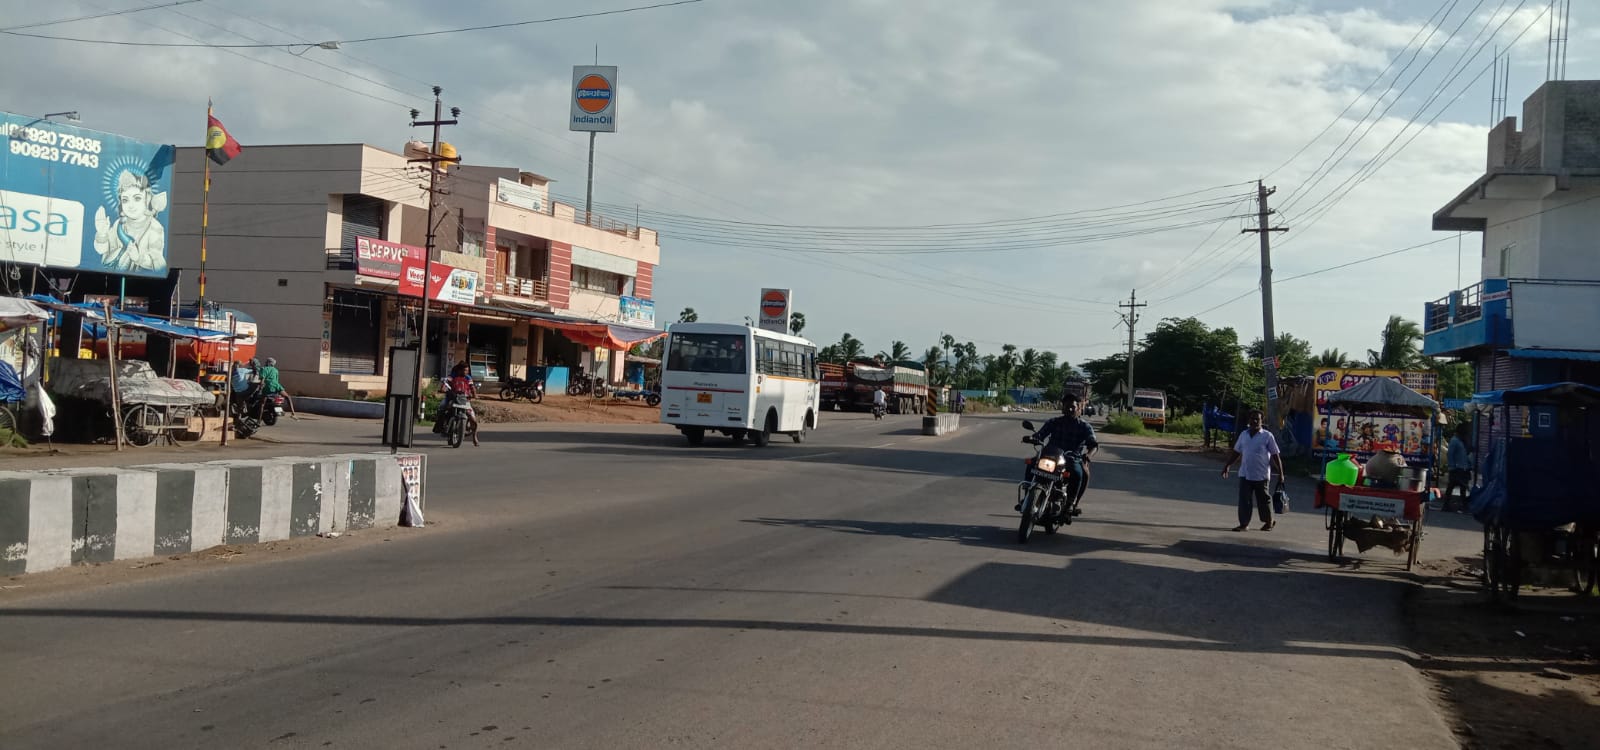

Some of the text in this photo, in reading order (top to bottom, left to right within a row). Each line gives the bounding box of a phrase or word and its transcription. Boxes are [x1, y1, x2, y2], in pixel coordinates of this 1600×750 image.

[573, 115, 612, 125] IndianOil
[10, 140, 59, 162] 90923
[59, 133, 101, 154] 73935
